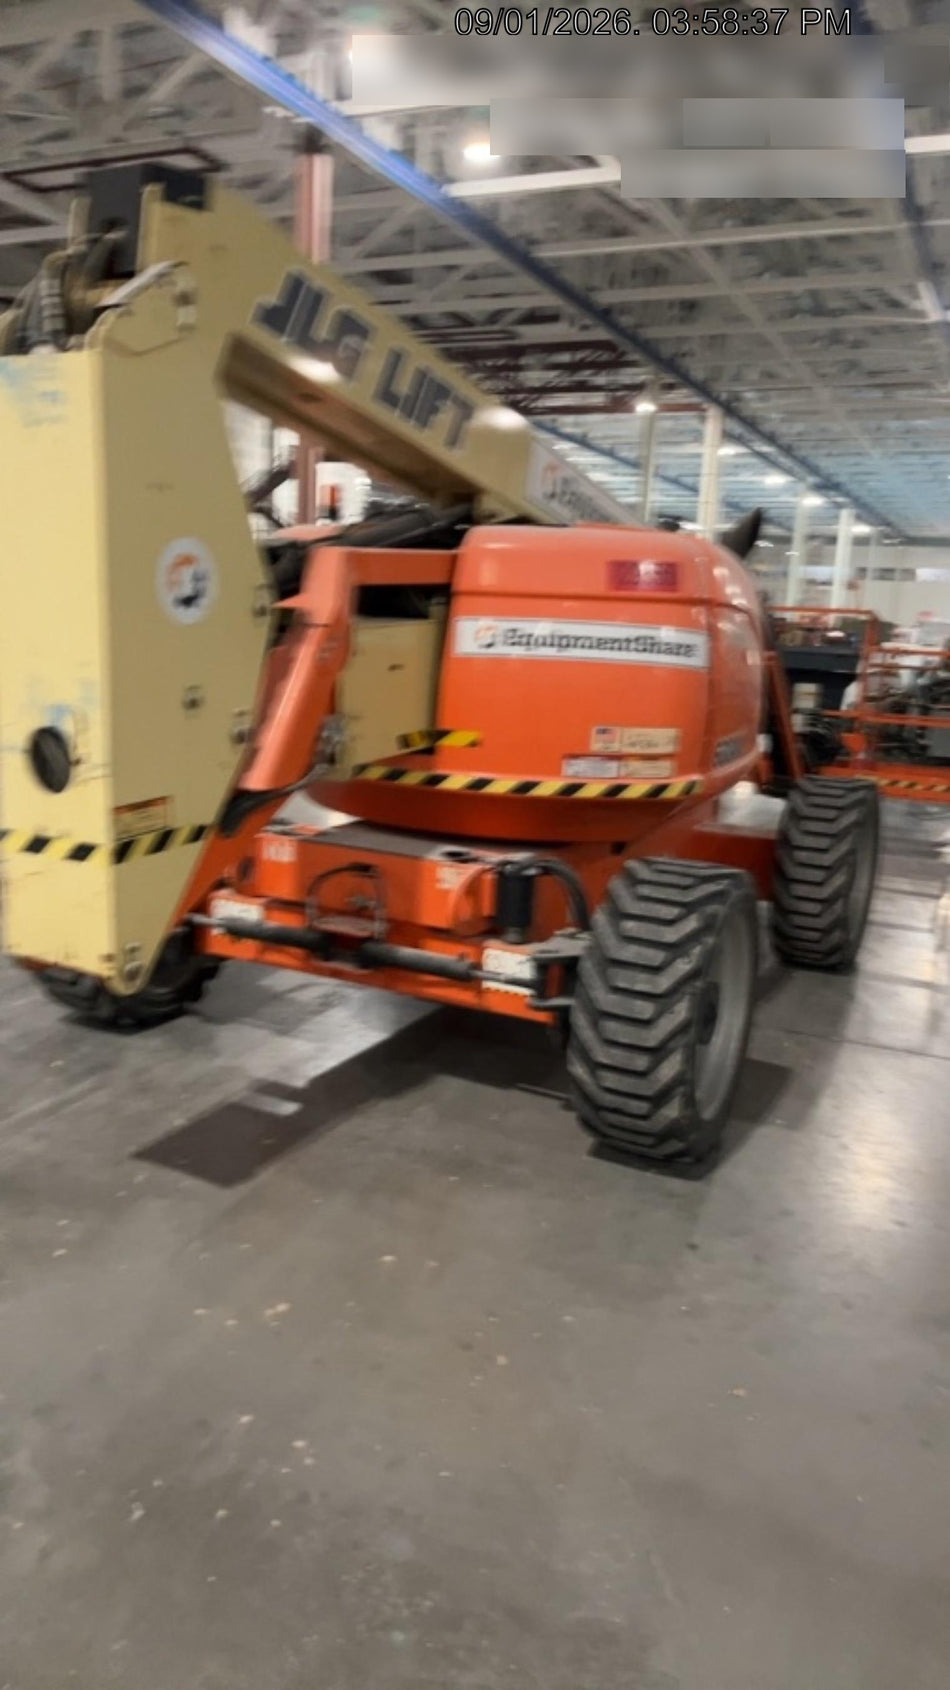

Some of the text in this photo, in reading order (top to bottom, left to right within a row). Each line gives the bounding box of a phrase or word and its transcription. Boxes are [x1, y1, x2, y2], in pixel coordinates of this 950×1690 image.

[252, 268, 475, 449] JLG LIFT
[503, 627, 698, 658] EquipmentShare
